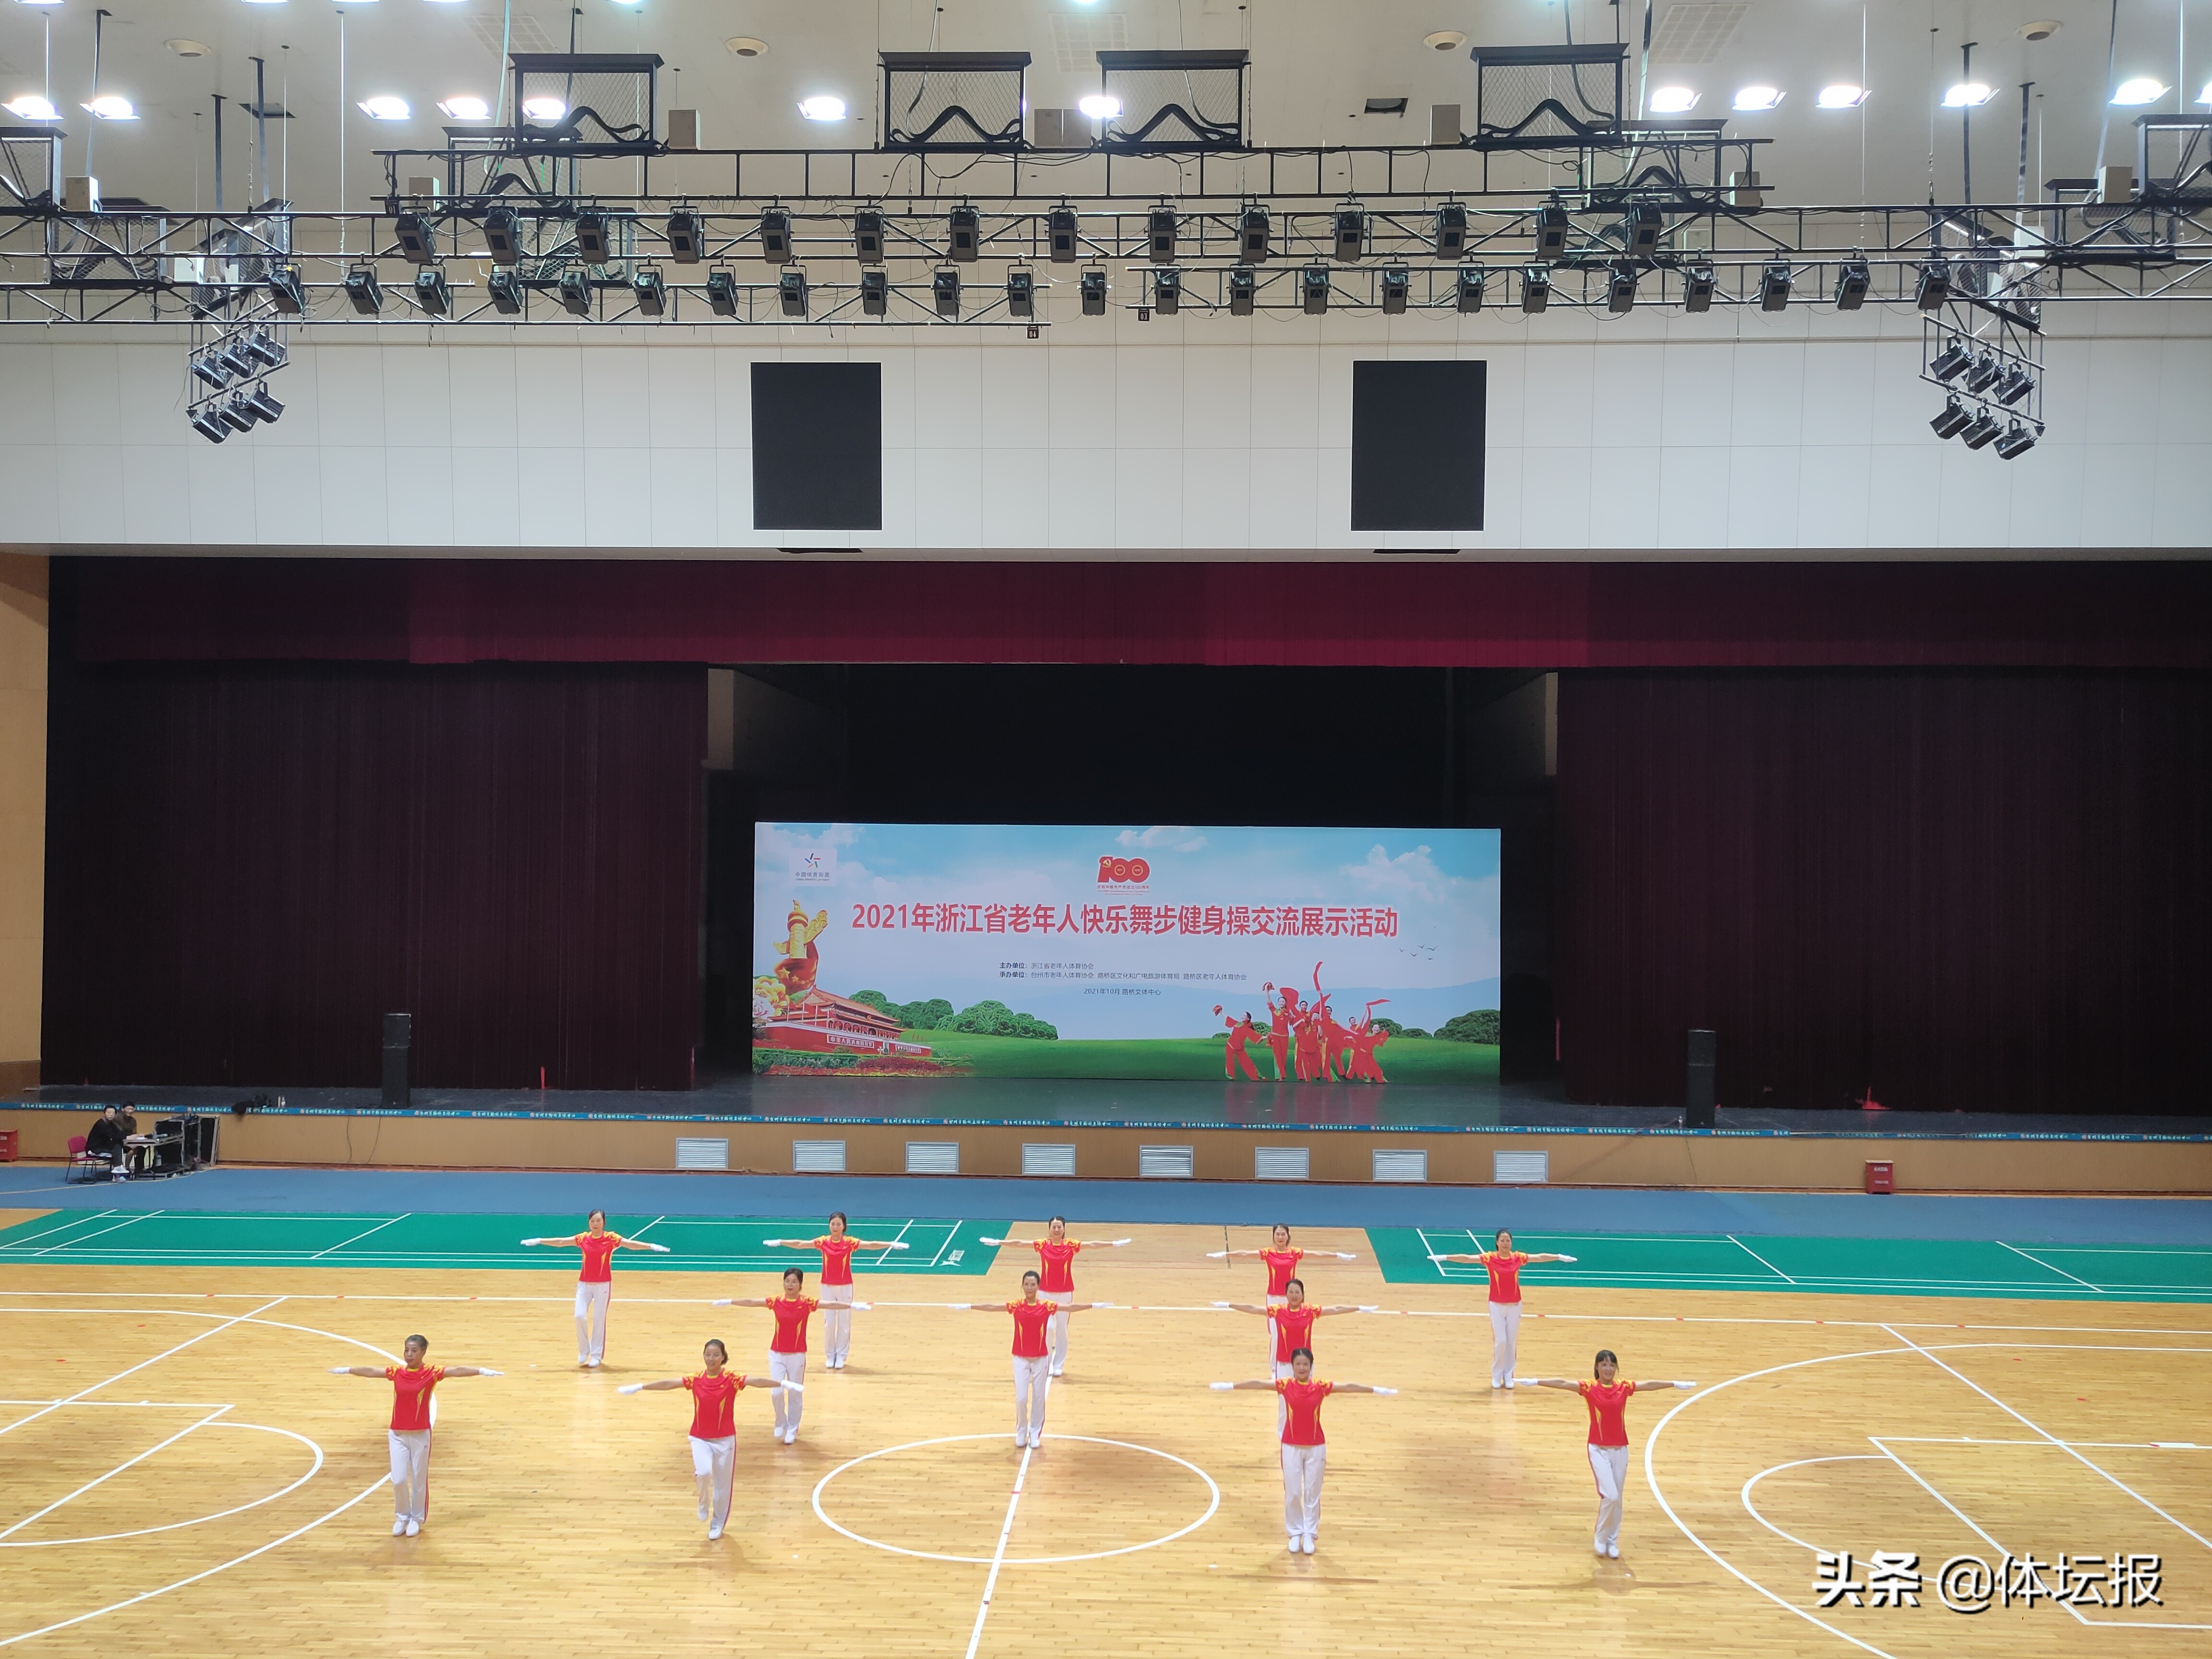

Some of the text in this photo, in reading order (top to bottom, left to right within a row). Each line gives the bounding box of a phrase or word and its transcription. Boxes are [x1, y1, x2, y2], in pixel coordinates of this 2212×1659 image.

[852, 902, 1397, 938] 2021年浙江省老年人快乐舞步健身操交流展示活动
